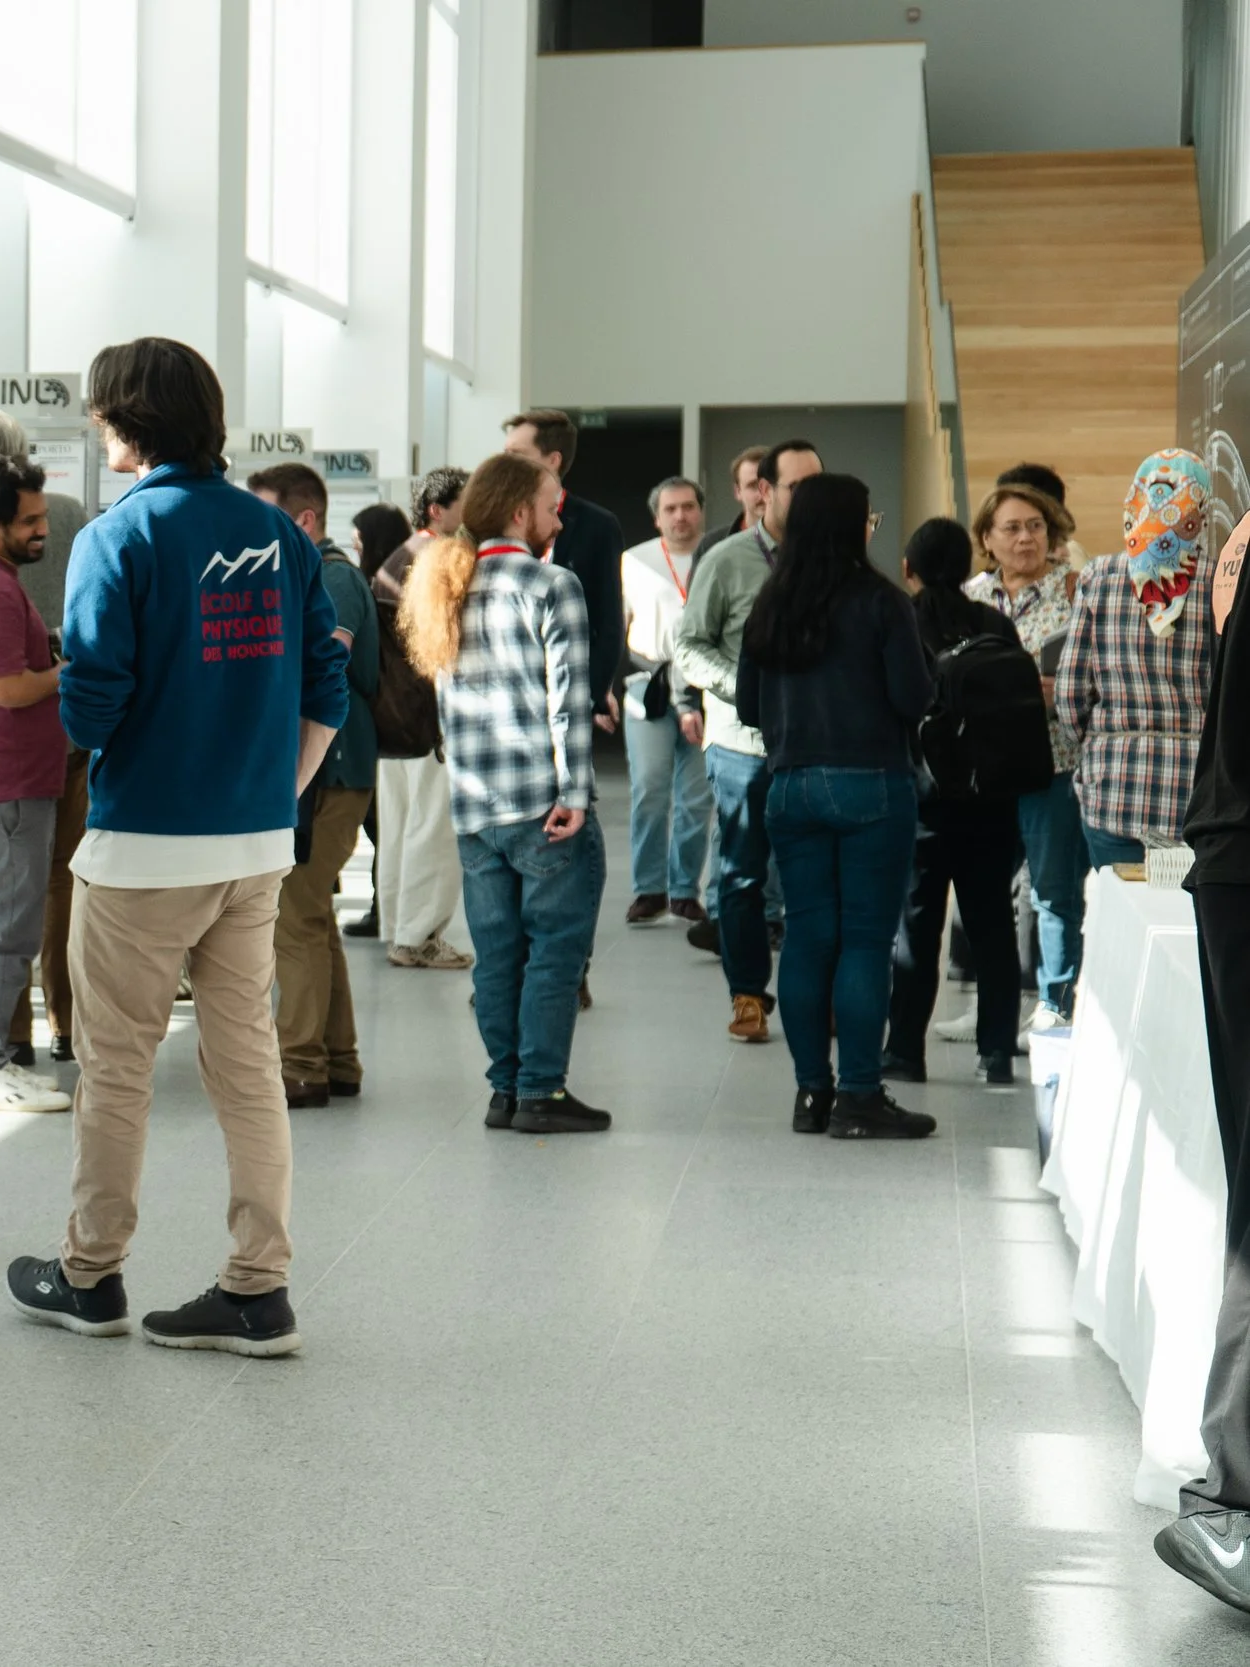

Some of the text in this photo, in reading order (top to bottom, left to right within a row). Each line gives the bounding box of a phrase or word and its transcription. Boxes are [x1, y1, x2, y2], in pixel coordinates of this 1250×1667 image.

[1, 379, 47, 405] INL
[251, 432, 292, 452] INL
[324, 454, 358, 473] INL
[202, 614, 285, 641] PHYSIQUE
